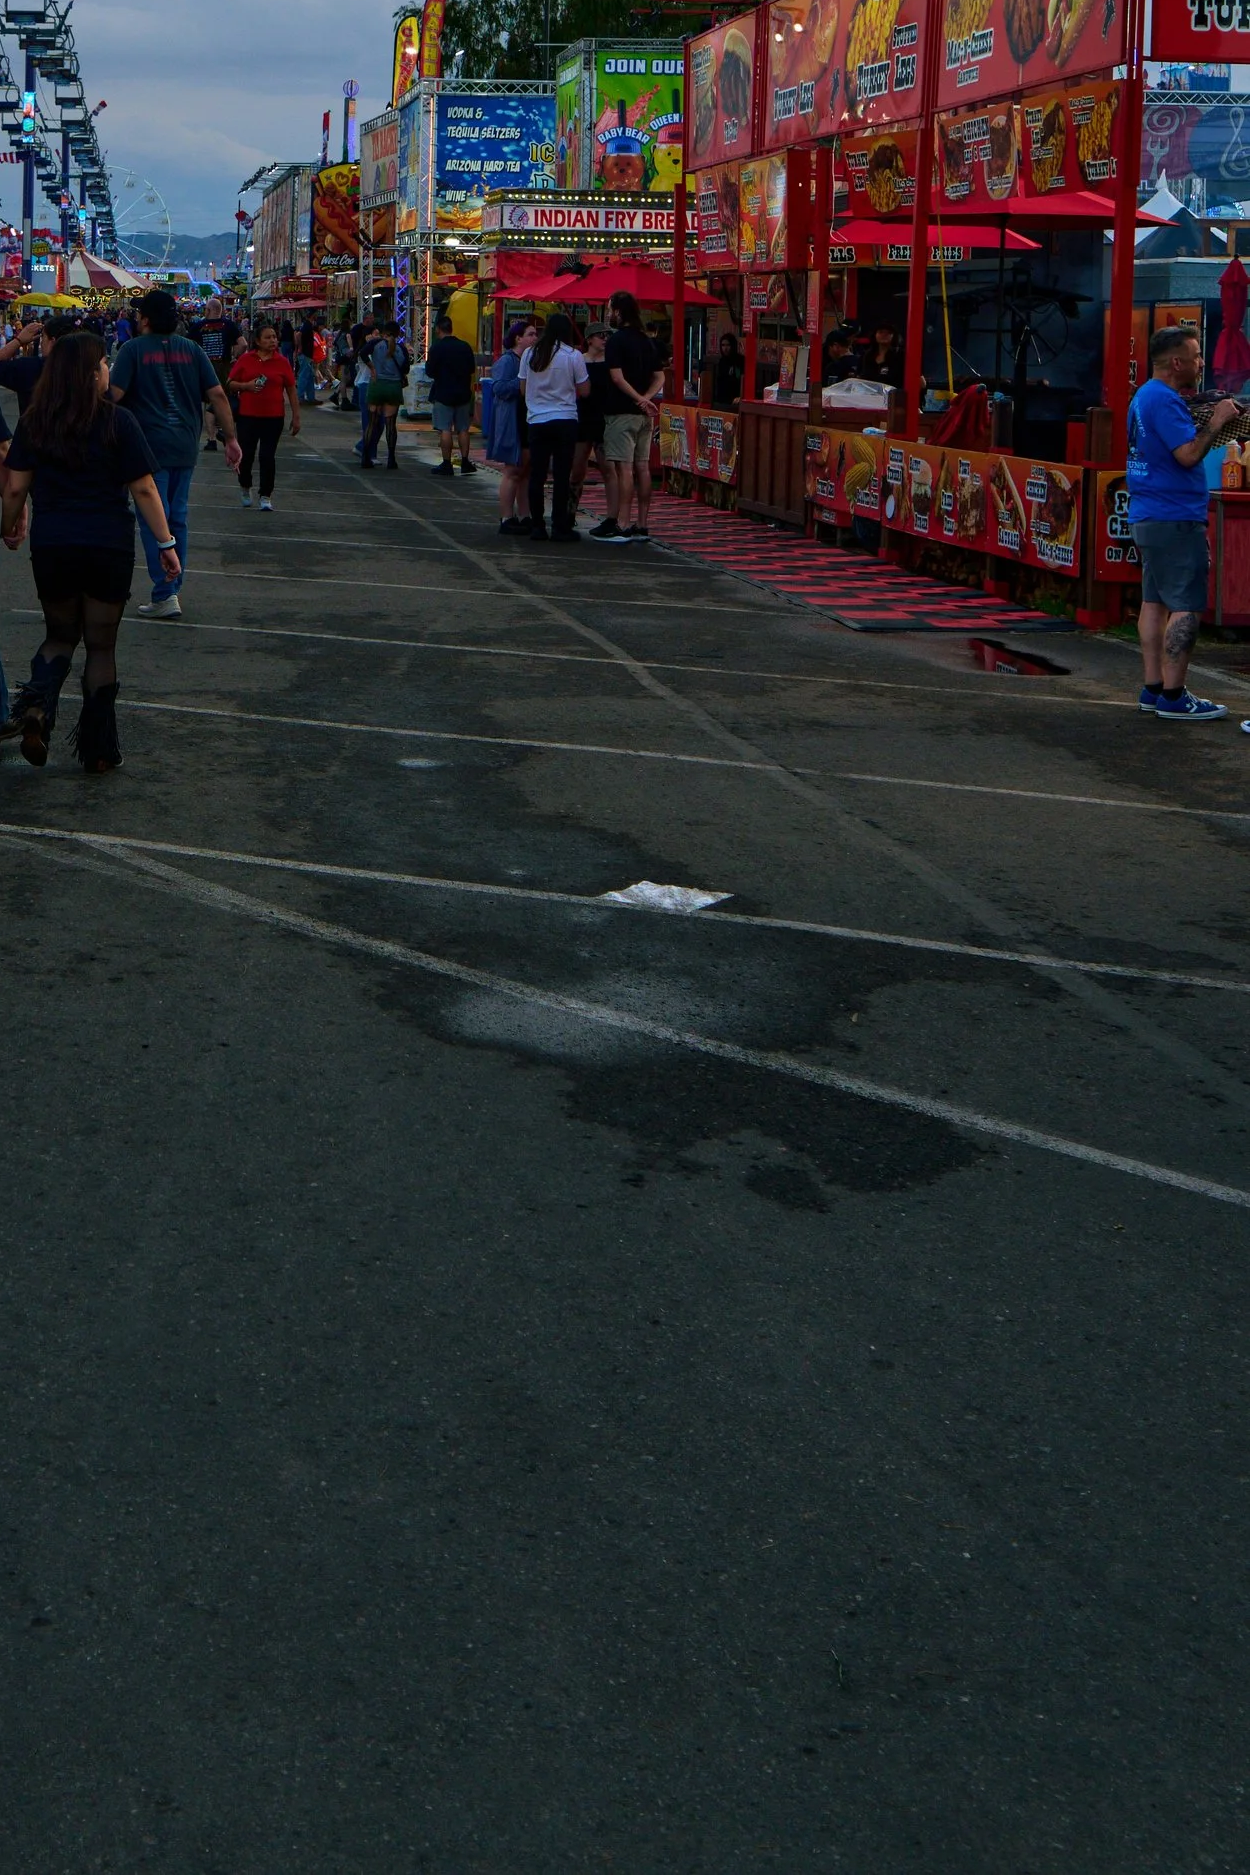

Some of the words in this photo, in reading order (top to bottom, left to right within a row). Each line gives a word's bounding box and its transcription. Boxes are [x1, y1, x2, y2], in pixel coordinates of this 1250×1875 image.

[892, 21, 918, 50] STUFFED
[605, 58, 647, 75] JOIN
[856, 60, 891, 102] TURKEY
[892, 52, 918, 92] LEGS
[773, 86, 798, 121] TURKEY
[798, 79, 816, 115] LEGS
[447, 106, 474, 120] VODKA
[475, 107, 484, 119] &
[650, 113, 680, 132] QUEEN
[1025, 107, 1043, 128] TURKEY
[446, 126, 480, 139] TEQUILA
[481, 127, 521, 140] SELTZERS
[597, 127, 625, 146] BABY
[624, 127, 651, 146] BEAR
[962, 114, 991, 144] CHICKEN
[530, 142, 555, 165] IC
[845, 150, 870, 171] TURKEY
[445, 159, 482, 173] ARIZONA
[482, 161, 505, 173] HARD
[506, 161, 521, 173] TEA
[1084, 158, 1111, 181] TURKEY
[446, 190, 467, 203] WINE
[534, 209, 599, 229] INDIAN
[605, 210, 638, 229] FRY
[320, 254, 340, 267] West
[888, 244, 912, 263] FRE
[931, 244, 964, 263] FRIES
[31, 264, 56, 273] KETS
[998, 526, 1020, 551] SAUSAGE
[1106, 545, 1126, 564] ON
[1127, 545, 1140, 563] A
